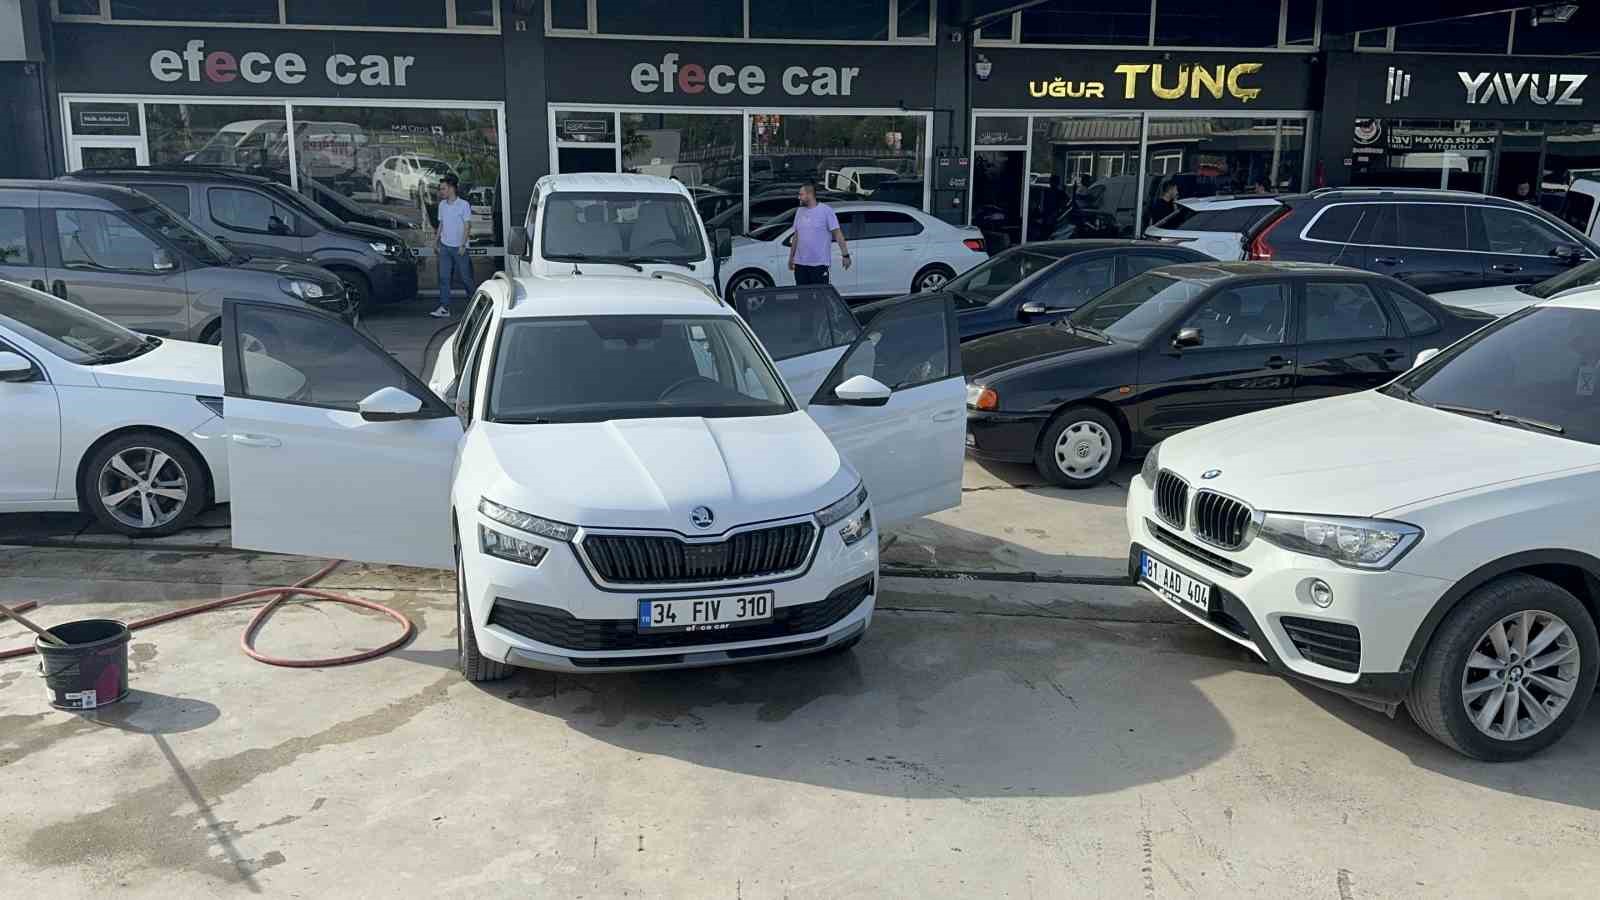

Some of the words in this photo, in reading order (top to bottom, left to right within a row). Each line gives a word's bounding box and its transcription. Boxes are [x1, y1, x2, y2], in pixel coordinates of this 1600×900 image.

[150, 40, 307, 84] efece
[325, 53, 415, 86] car
[630, 53, 766, 95] efece
[782, 66, 860, 96] car
[1029, 77, 1104, 98] UĞUR
[1113, 63, 1264, 103] TUNÇ
[1457, 71, 1588, 105] YAVUZ
[1147, 559, 1158, 582] 81
[1163, 568, 1182, 594] AAD
[1187, 580, 1207, 607] 404
[653, 603, 677, 624] 34
[693, 600, 721, 622] FIV
[736, 596, 767, 618] 310
